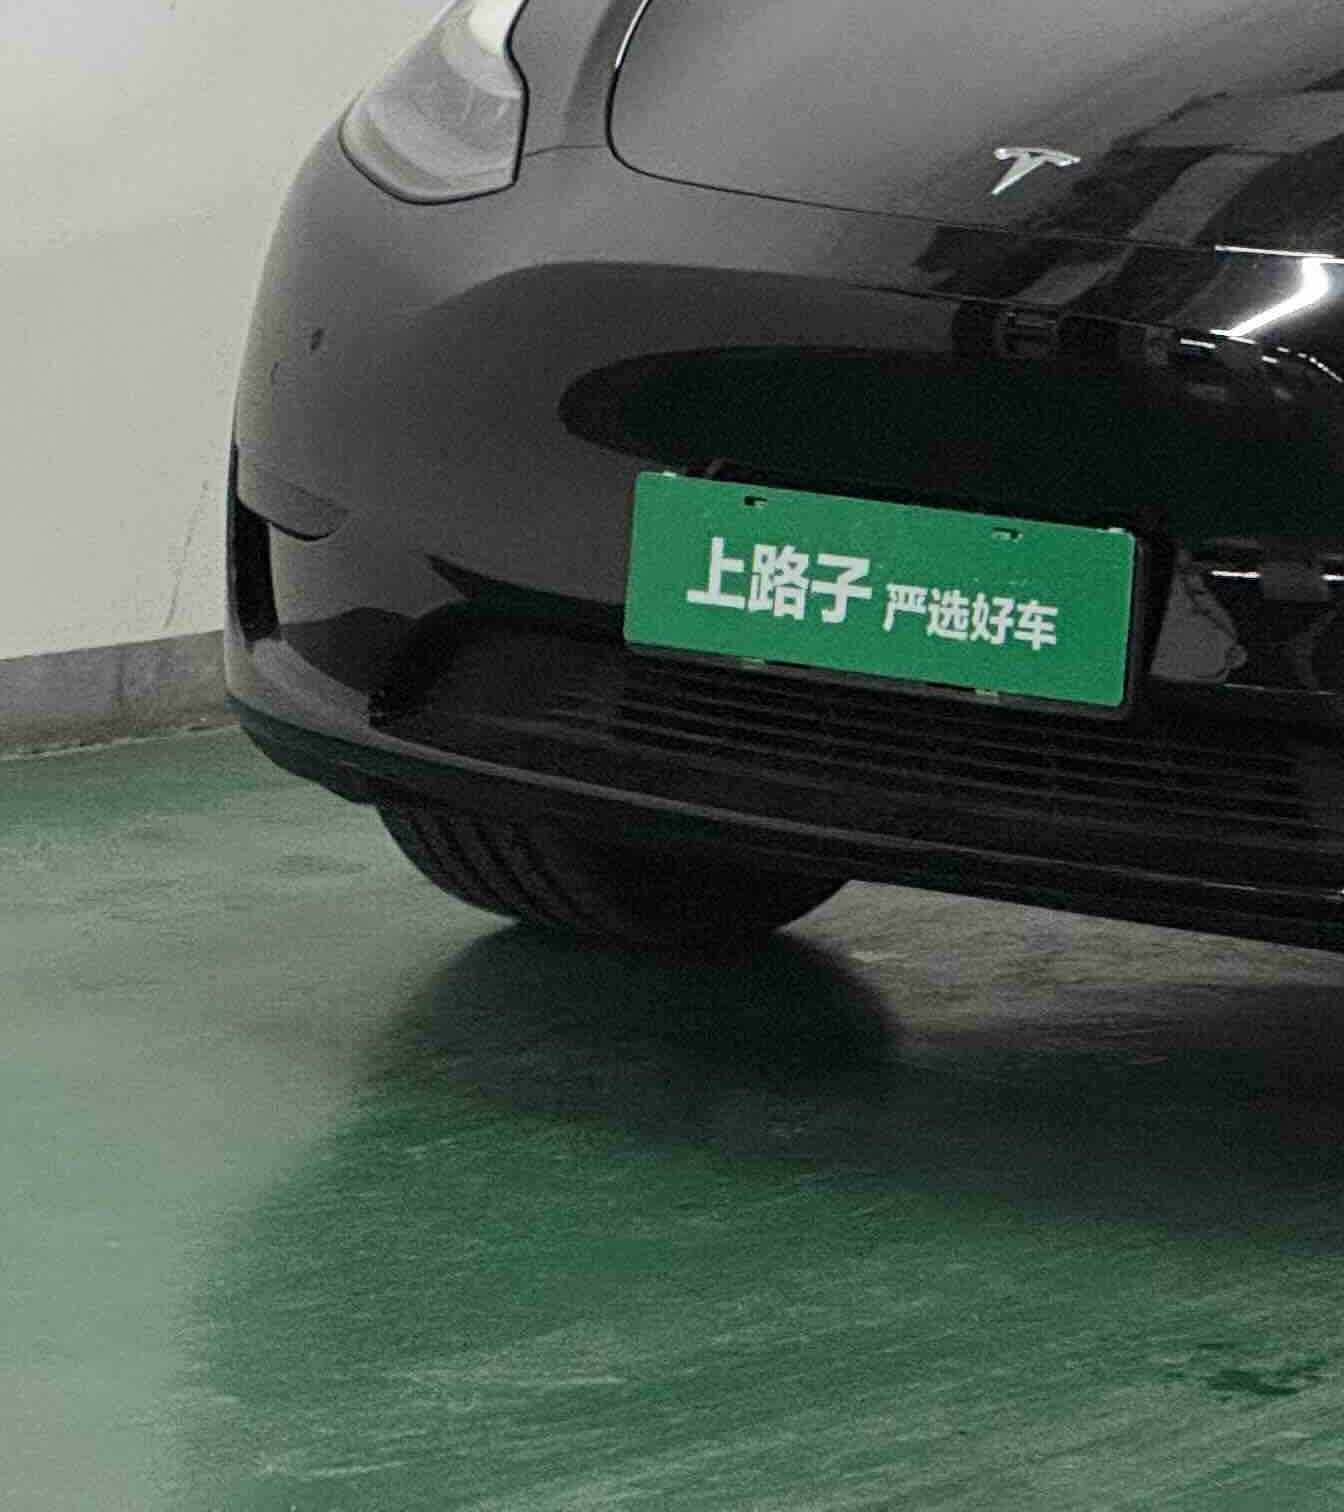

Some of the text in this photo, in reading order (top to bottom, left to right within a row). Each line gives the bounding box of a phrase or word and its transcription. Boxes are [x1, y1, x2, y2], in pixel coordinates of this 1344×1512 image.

[686, 536, 1059, 651] 上路子 严选好车
